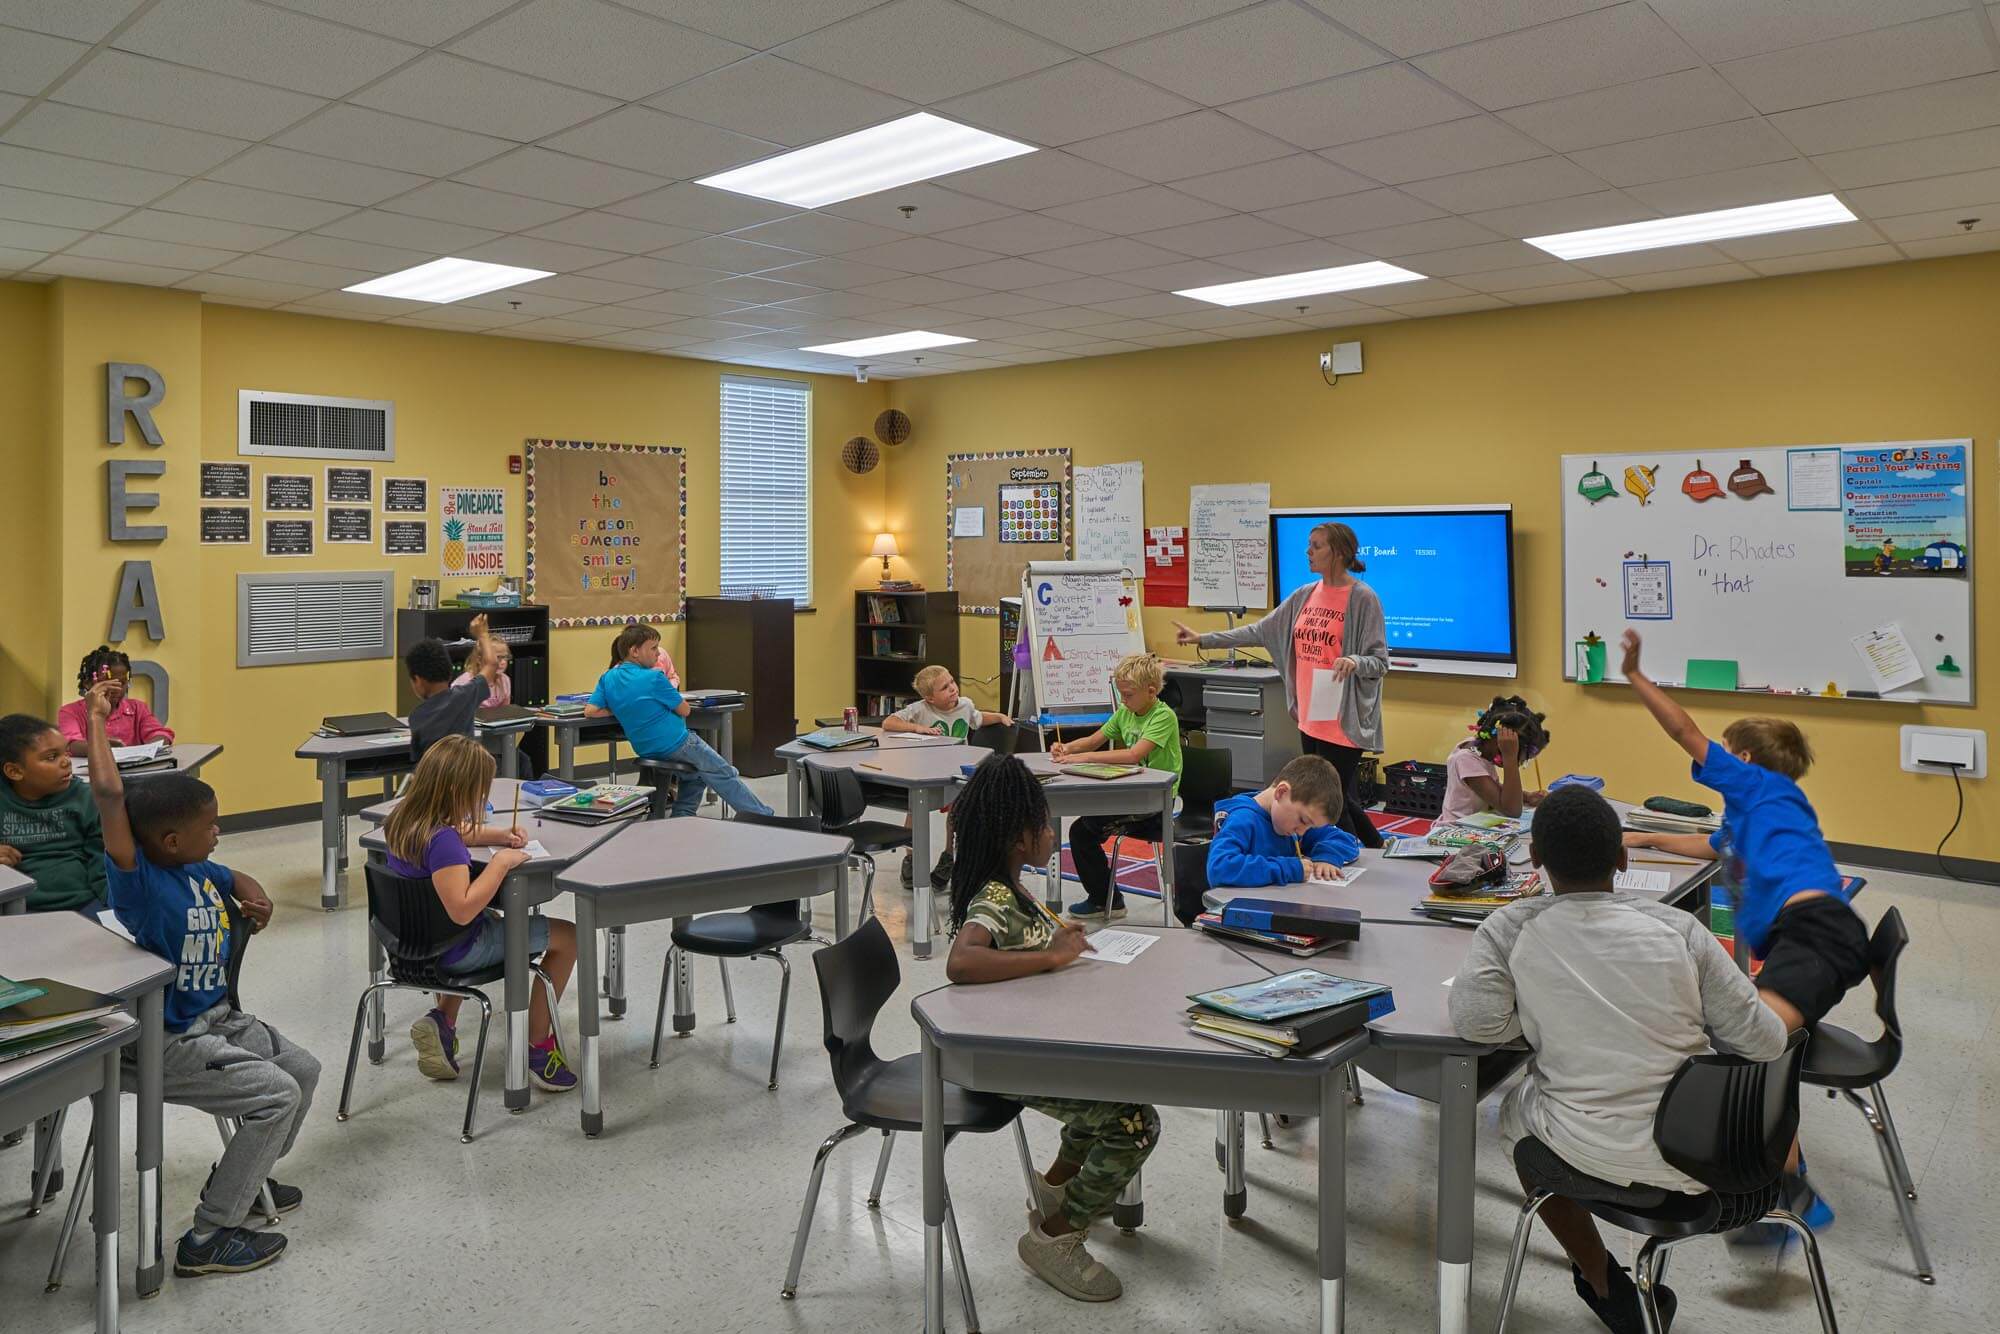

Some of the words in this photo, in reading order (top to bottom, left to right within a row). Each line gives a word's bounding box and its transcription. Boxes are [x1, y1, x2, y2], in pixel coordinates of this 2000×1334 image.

[1937, 451, 1948, 460] to
[1011, 467, 1048, 480] September
[1846, 464, 1880, 473] Patrol
[1885, 462, 1910, 472] Your
[1915, 461, 1961, 471] Writing
[599, 470, 617, 486] be
[1847, 477, 1882, 486] Capitals
[592, 493, 621, 508] the
[1846, 491, 1871, 500] Order
[1891, 491, 1946, 499] Organization
[457, 494, 503, 514] PINEAPPLE
[1848, 508, 1898, 517] Punctuation
[467, 523, 487, 533] Stand
[489, 522, 503, 533] Tall
[580, 519, 634, 530] reason
[1848, 524, 1883, 534] Spelling
[571, 534, 640, 546] someone
[1694, 534, 1720, 560] Dr.
[1729, 535, 1796, 561] Rhodes
[467, 553, 503, 569] INSIDE
[583, 550, 632, 566] smiles
[581, 567, 636, 591] today!
[1313, 608, 1345, 622] STUDENTS
[1304, 617, 1319, 627] HAVE
[1319, 619, 1330, 628] AN
[1302, 643, 1323, 656] TEACHER
[187, 906, 217, 931] GOT
[181, 932, 217, 963] MY
[176, 964, 218, 991] EYE
